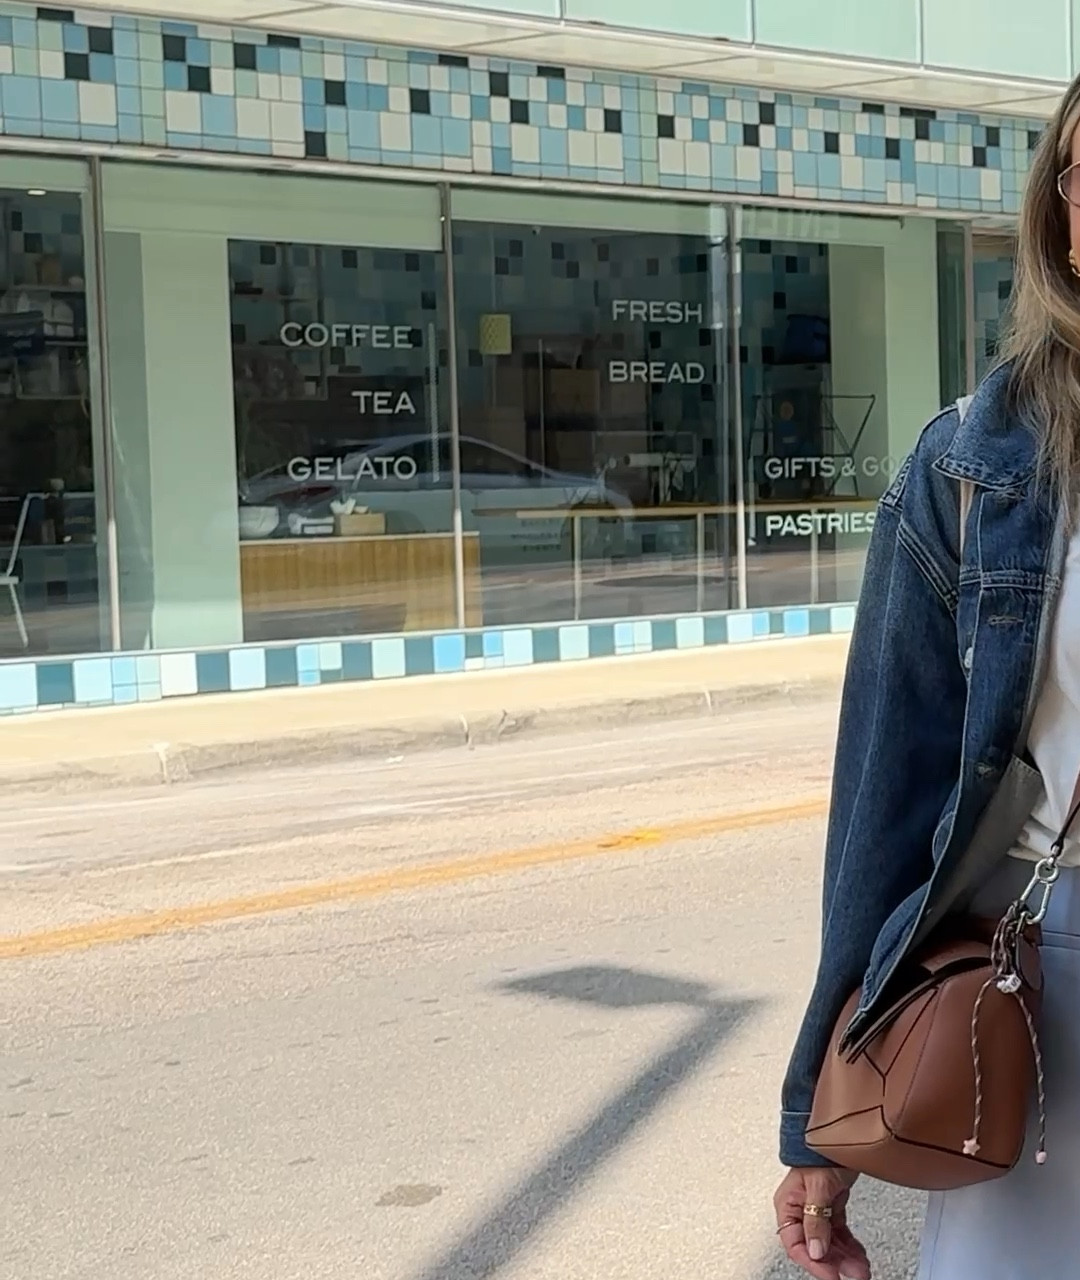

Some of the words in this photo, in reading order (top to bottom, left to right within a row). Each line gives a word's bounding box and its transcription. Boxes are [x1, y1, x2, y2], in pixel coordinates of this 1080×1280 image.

[611, 299, 703, 324] FRESH
[279, 321, 414, 350] COFFEE
[608, 361, 705, 384] BREAD
[351, 390, 416, 415] TEA
[287, 456, 418, 483] GELATO
[764, 457, 836, 479] GIFTS
[841, 457, 857, 477] &
[862, 455, 905, 477] GO
[765, 512, 876, 537] PASTRIES
